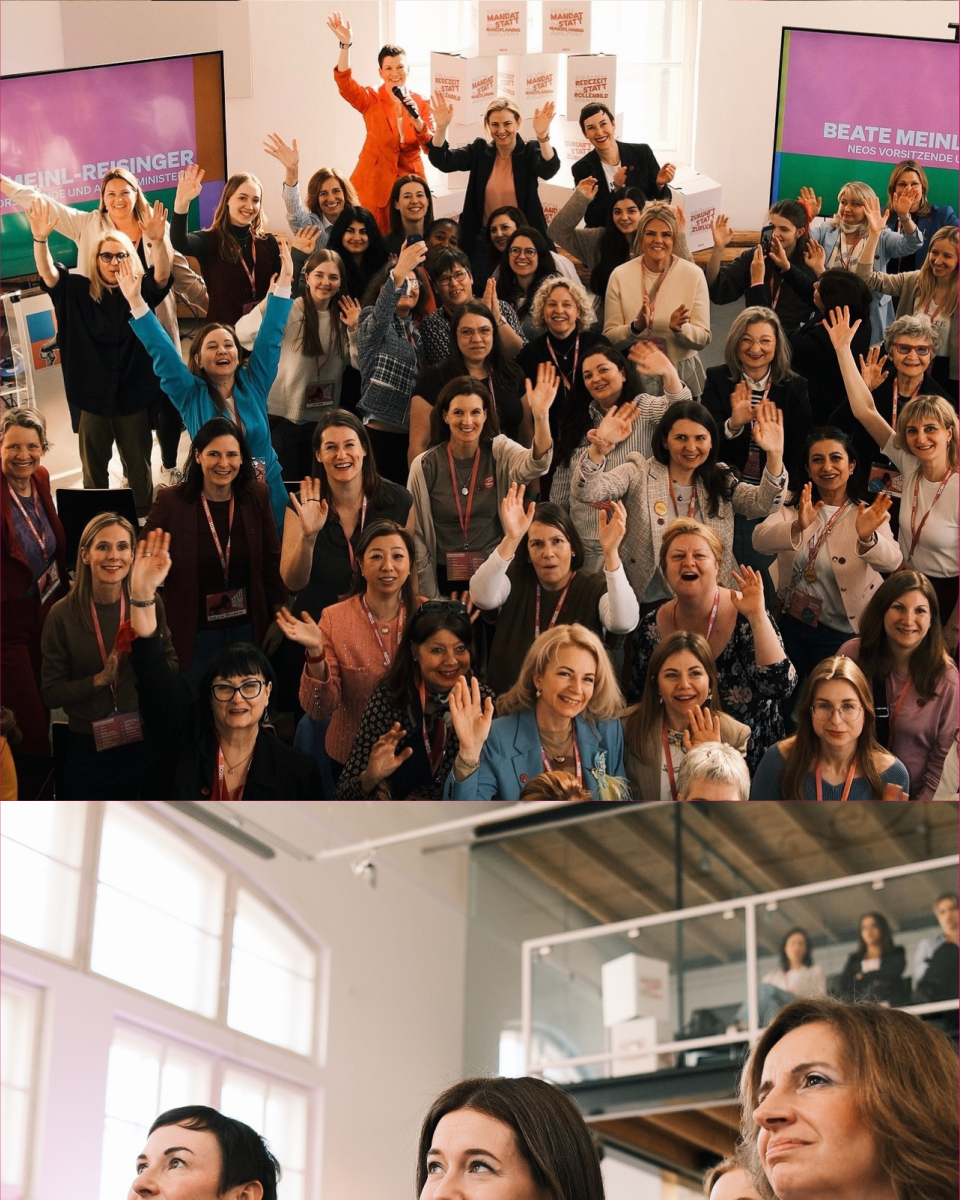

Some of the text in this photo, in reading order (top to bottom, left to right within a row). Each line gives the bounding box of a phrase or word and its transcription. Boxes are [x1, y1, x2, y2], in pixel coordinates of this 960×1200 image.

[487, 12, 519, 21] MANDAT
[550, 12, 583, 20] MANDAT
[495, 19, 518, 28] STATT
[558, 19, 582, 28] STATT
[472, 75, 494, 89] MANDAT
[526, 74, 553, 85] MANDAT
[575, 77, 607, 86] REDEZEIT
[477, 83, 494, 94] STATT
[532, 81, 553, 91] STATT
[583, 84, 607, 93] STATT
[823, 122, 892, 144] BEATE
[847, 144, 953, 163] NEOS VORSITZENDE
[68, 184, 92, 198] UND
[690, 207, 716, 221] ZUKUNFT
[696, 214, 715, 226] STATT
[367, 611, 375, 625] NEOS
[382, 651, 391, 665] NEOS
[424, 739, 432, 754] NEOS
